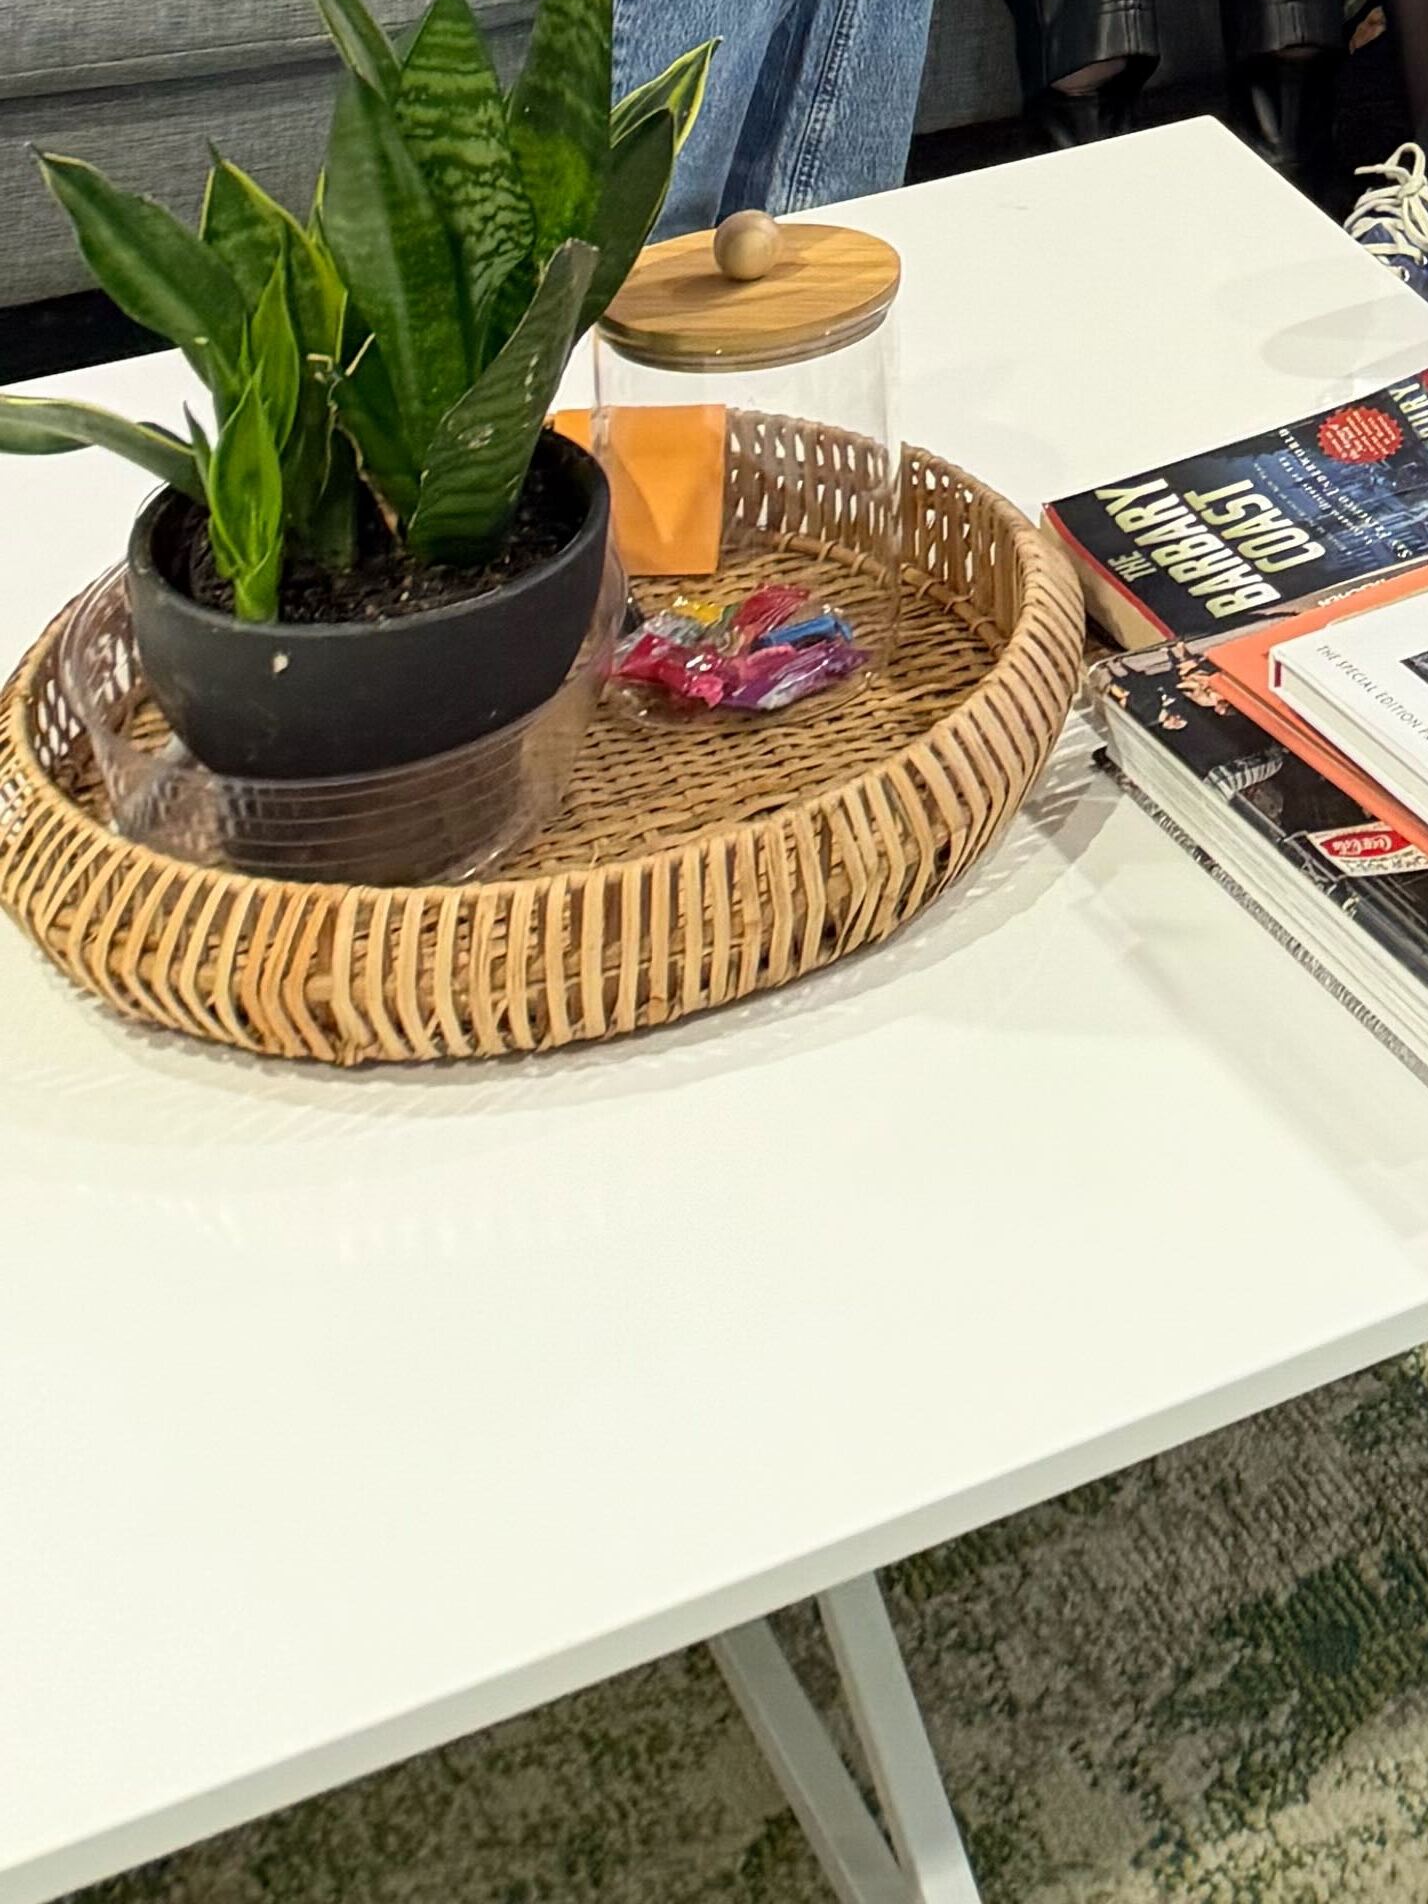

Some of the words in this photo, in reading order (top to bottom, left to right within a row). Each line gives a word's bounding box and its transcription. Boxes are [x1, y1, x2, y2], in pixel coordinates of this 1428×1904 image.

[1095, 478, 1281, 618] BARBARY
[1107, 550, 1157, 583] THE
[1184, 479, 1326, 573] COAST
[1316, 644, 1337, 667] THE
[1335, 659, 1377, 694] SPECIAL
[1374, 686, 1422, 730] EDITION
